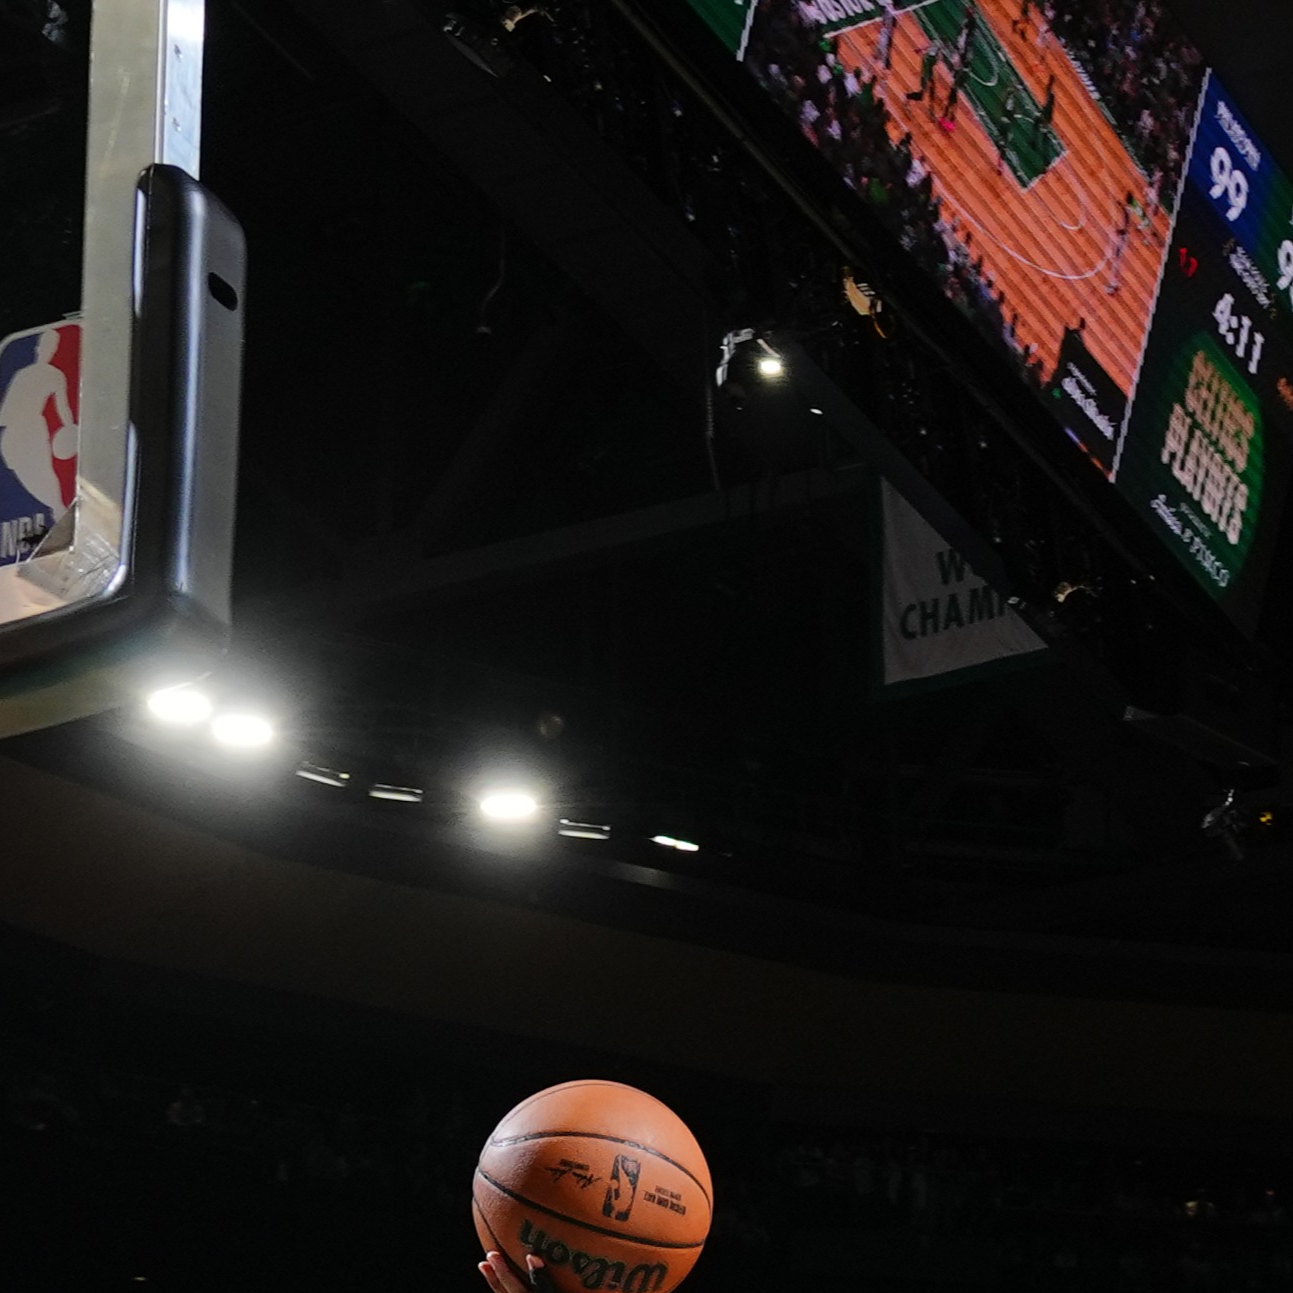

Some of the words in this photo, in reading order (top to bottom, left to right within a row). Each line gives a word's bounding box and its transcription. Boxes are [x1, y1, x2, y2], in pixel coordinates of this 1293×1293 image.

[1210, 146, 1249, 222] 99
[1213, 293, 1265, 375] 4:11
[518, 1218, 670, 1293] Wilson
